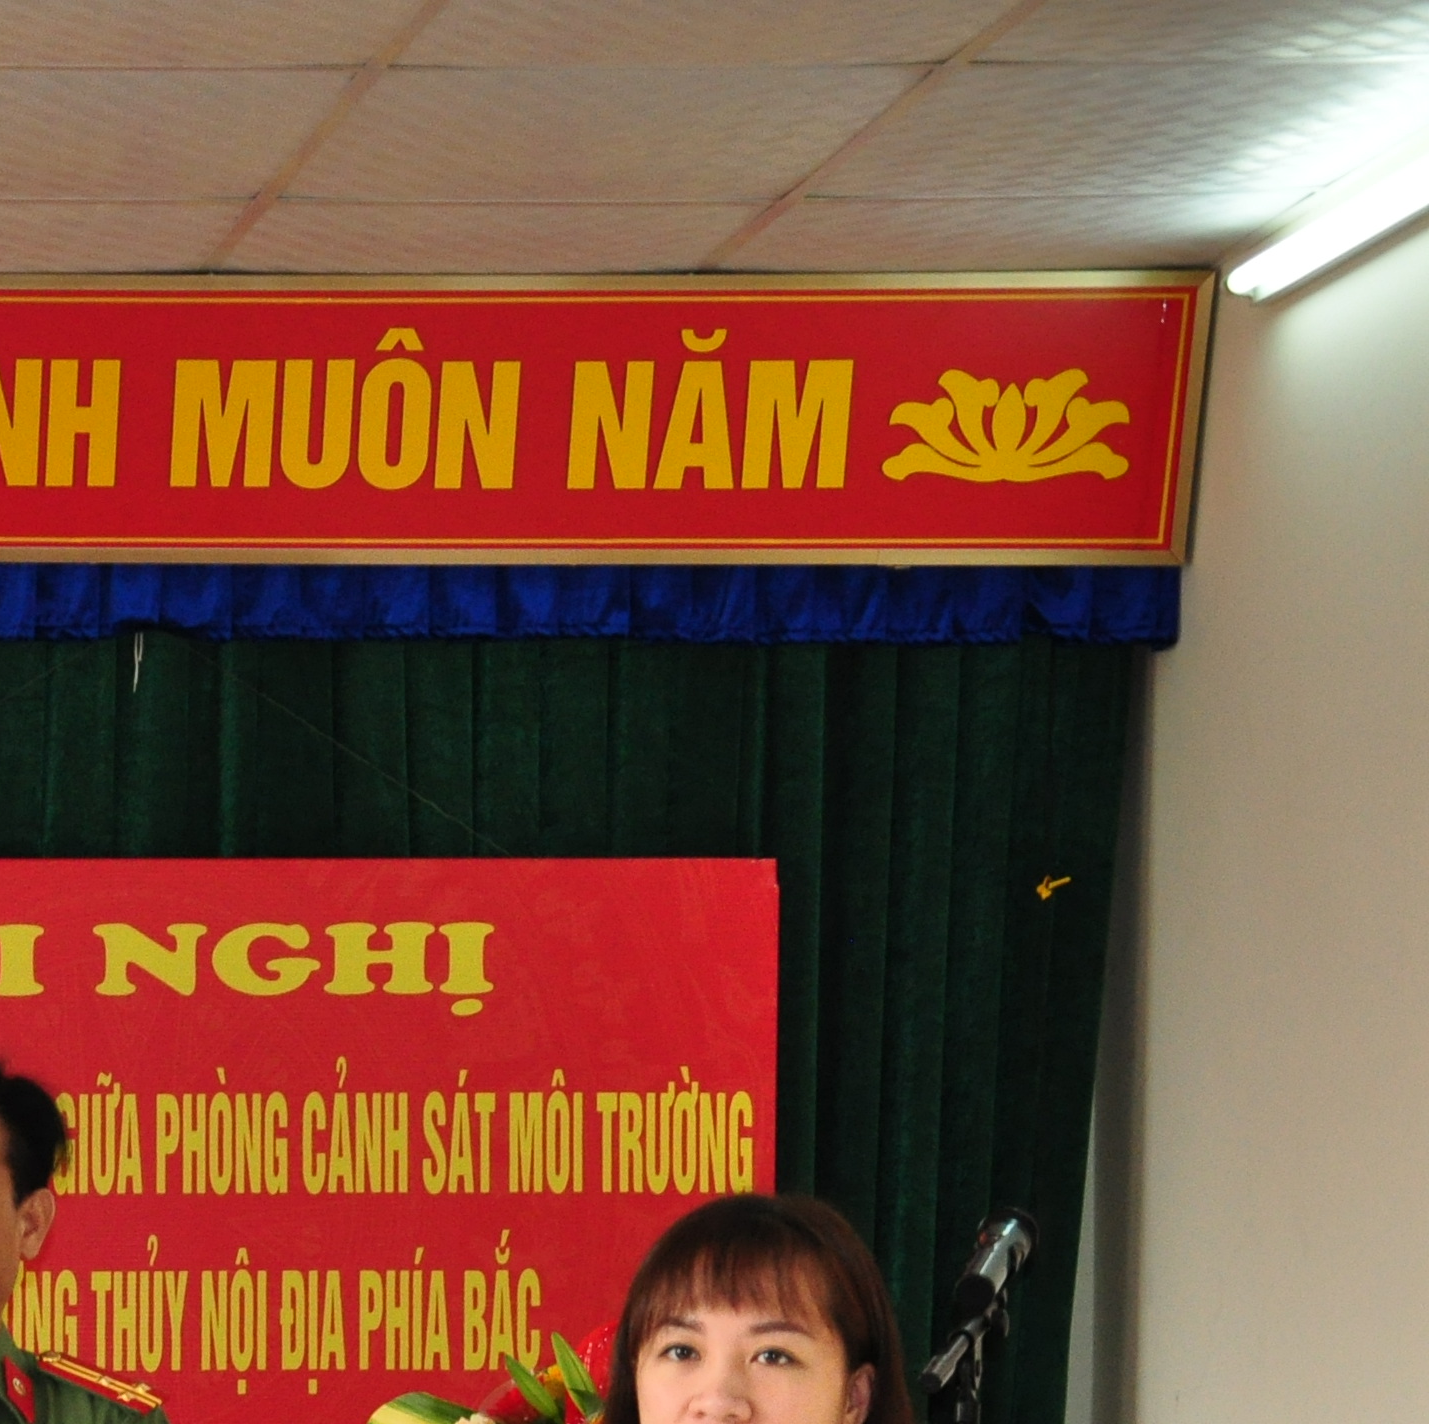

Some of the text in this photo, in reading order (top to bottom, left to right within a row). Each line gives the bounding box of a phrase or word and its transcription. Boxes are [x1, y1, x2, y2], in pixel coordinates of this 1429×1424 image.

[170, 329, 521, 490] MUÔN
[567, 330, 854, 489] NĂM
[93, 922, 495, 1016] NGHỊ
[53, 1072, 143, 1196] GIỮA
[155, 1068, 288, 1195] PHÒNG
[301, 1057, 410, 1195] CẢNH
[422, 1070, 496, 1195] SÁT
[508, 1069, 584, 1195] MÔI
[596, 1066, 753, 1195] TRƯỜNG
[90, 1236, 188, 1372] THỦY
[201, 1248, 269, 1394] NỘI
[279, 1270, 347, 1394] ĐỊA
[359, 1247, 450, 1371] PHÍA
[463, 1229, 541, 1371] BẮC
